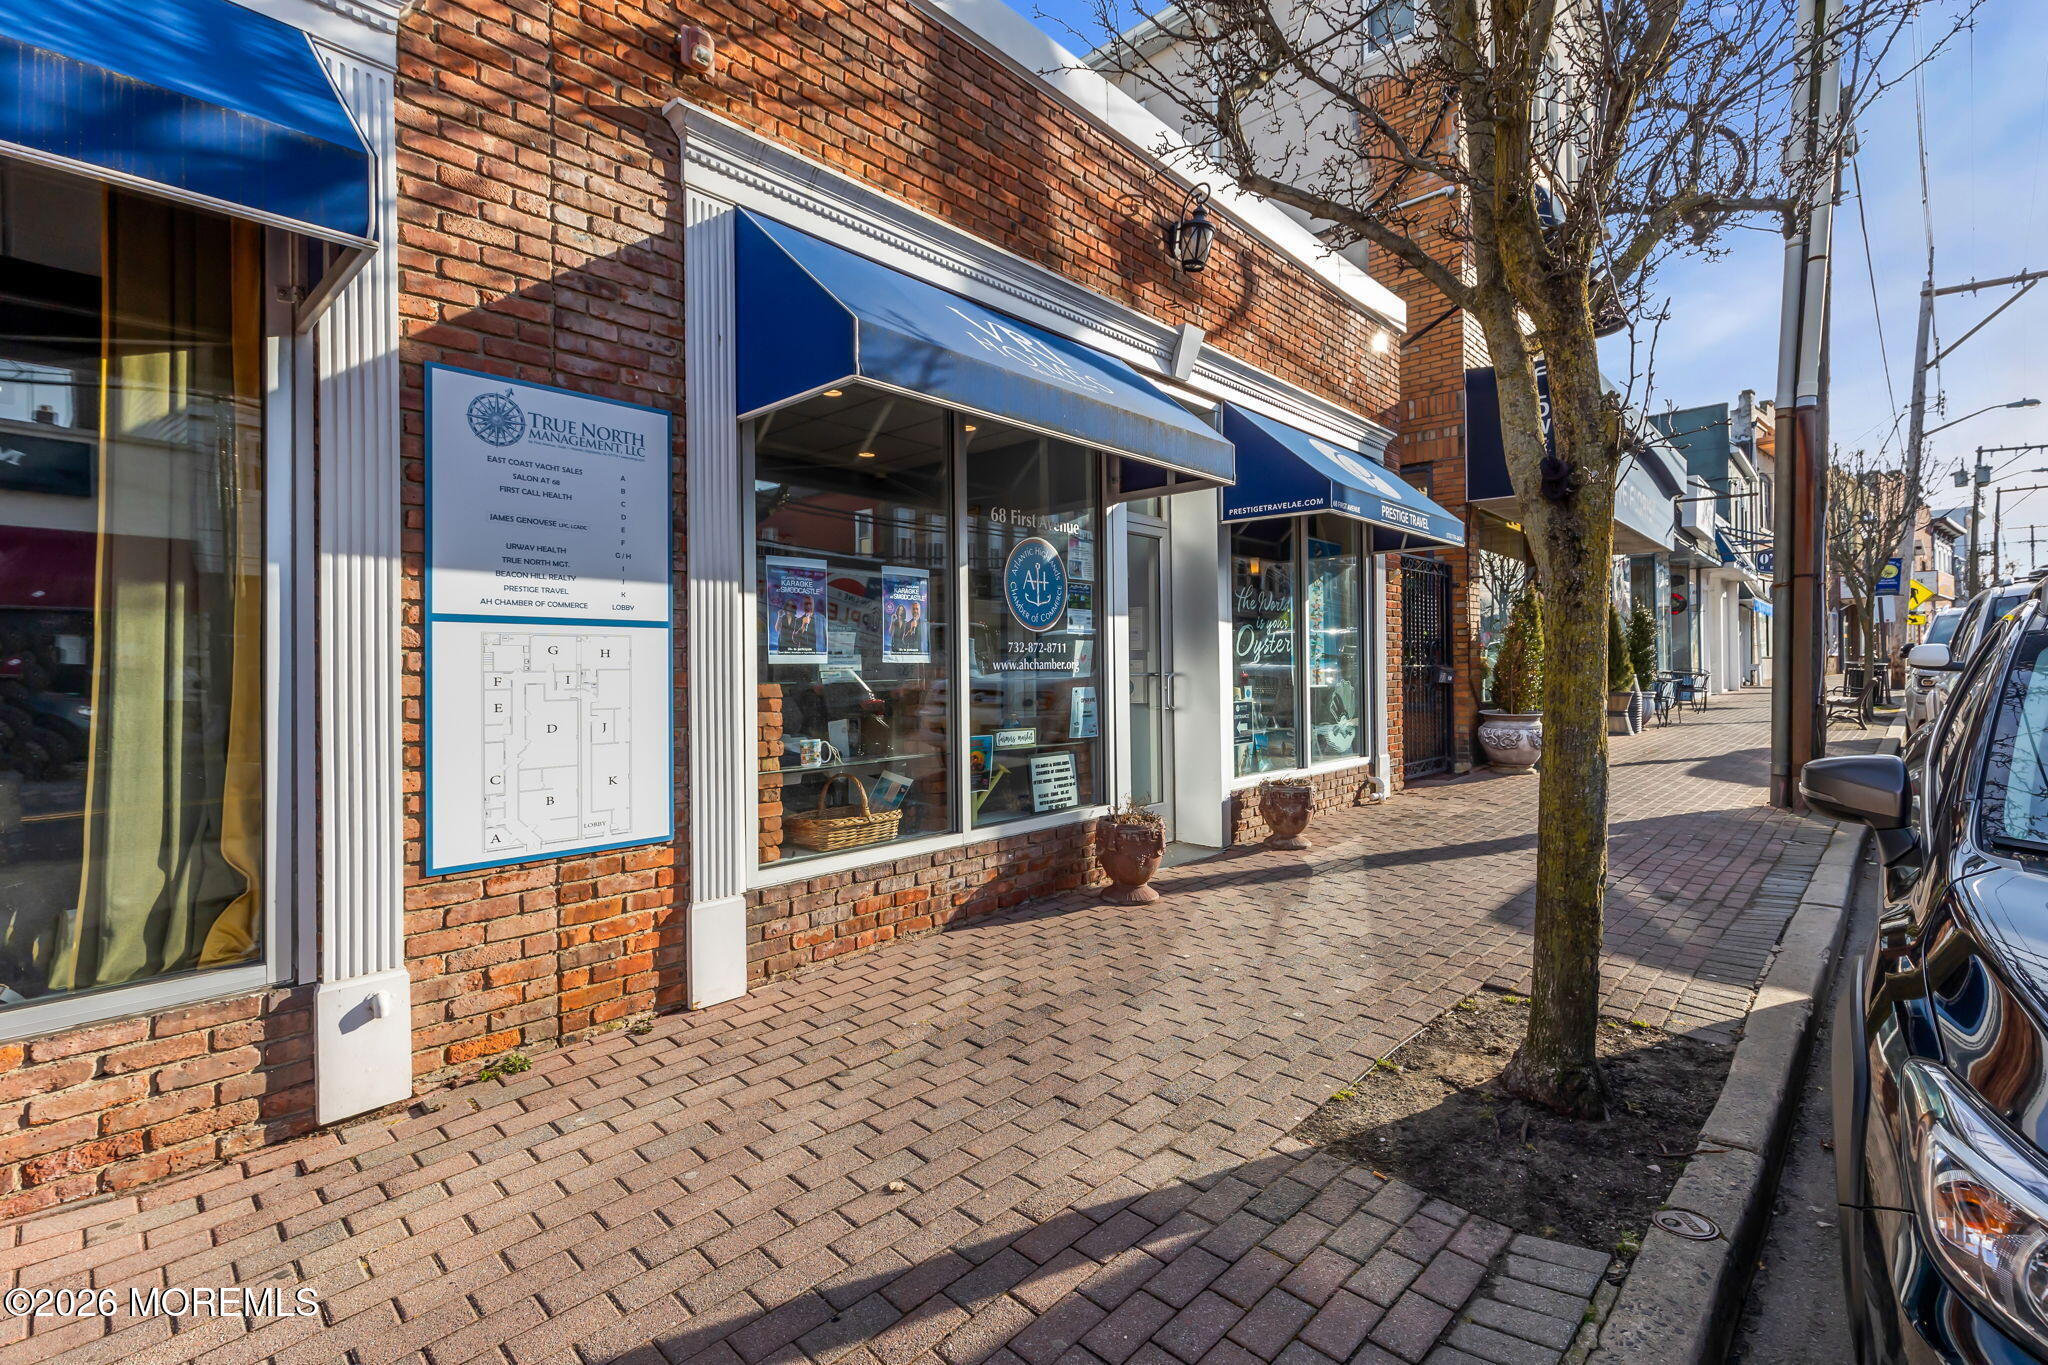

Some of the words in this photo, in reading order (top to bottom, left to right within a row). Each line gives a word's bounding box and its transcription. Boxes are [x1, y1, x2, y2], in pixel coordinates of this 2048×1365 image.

[965, 331, 1114, 394] HOMES
[528, 412, 576, 435] TRUE
[582, 422, 644, 447] NORTH
[528, 429, 623, 454] MANAGEMENT,
[625, 444, 646, 458] LLC
[487, 455, 506, 464] EAST
[508, 458, 533, 468] COAST
[535, 462, 560, 472] YACHT
[562, 466, 583, 476] SALES
[512, 473, 539, 483] SALON
[499, 485, 520, 494] FIRST
[521, 488, 541, 497] CALL
[542, 491, 573, 500] HEALTH
[1229, 497, 1324, 516] PRESTIGETRAVELAE.COM
[1338, 501, 1347, 510] FIRST
[1347, 504, 1361, 514] AVENUE
[490, 513, 514, 523] JAMES
[516, 516, 557, 527] GENOVESE
[990, 506, 1006, 523] 68
[1010, 509, 1036, 528] First
[1381, 505, 1408, 525] PRESTIGE
[1409, 512, 1430, 530] TRAVEL
[506, 542, 535, 552] URWAY
[536, 545, 567, 554] HEALTH
[502, 556, 522, 565] TRUE
[523, 558, 551, 567] NORTH
[552, 560, 570, 568] MGT.
[495, 570, 529, 579] BEACON
[530, 572, 547, 580] HILL
[548, 573, 577, 582] REALTY
[781, 580, 813, 588] KARAOKE
[503, 585, 539, 593] PRESTIGE
[541, 587, 569, 595] TRAVEL
[893, 587, 920, 595] KARAOKE
[494, 598, 534, 607] CHAMBER
[547, 601, 588, 609] COMMERCE
[1256, 617, 1264, 630] is
[1266, 619, 1289, 635] your
[1008, 641, 1067, 654] 732-872-8711
[1236, 624, 1291, 664] Oyster
[547, 645, 559, 655] G
[600, 649, 611, 658] H
[993, 658, 1080, 673] www.ahchamber.org
[493, 677, 502, 686] F
[566, 676, 570, 685] I
[494, 704, 503, 713] E
[547, 724, 558, 734] D
[602, 723, 607, 733] J
[490, 775, 501, 785] C
[608, 776, 618, 785] K
[546, 796, 555, 806] B
[584, 820, 607, 829] LOBBY
[491, 834, 502, 844] A
